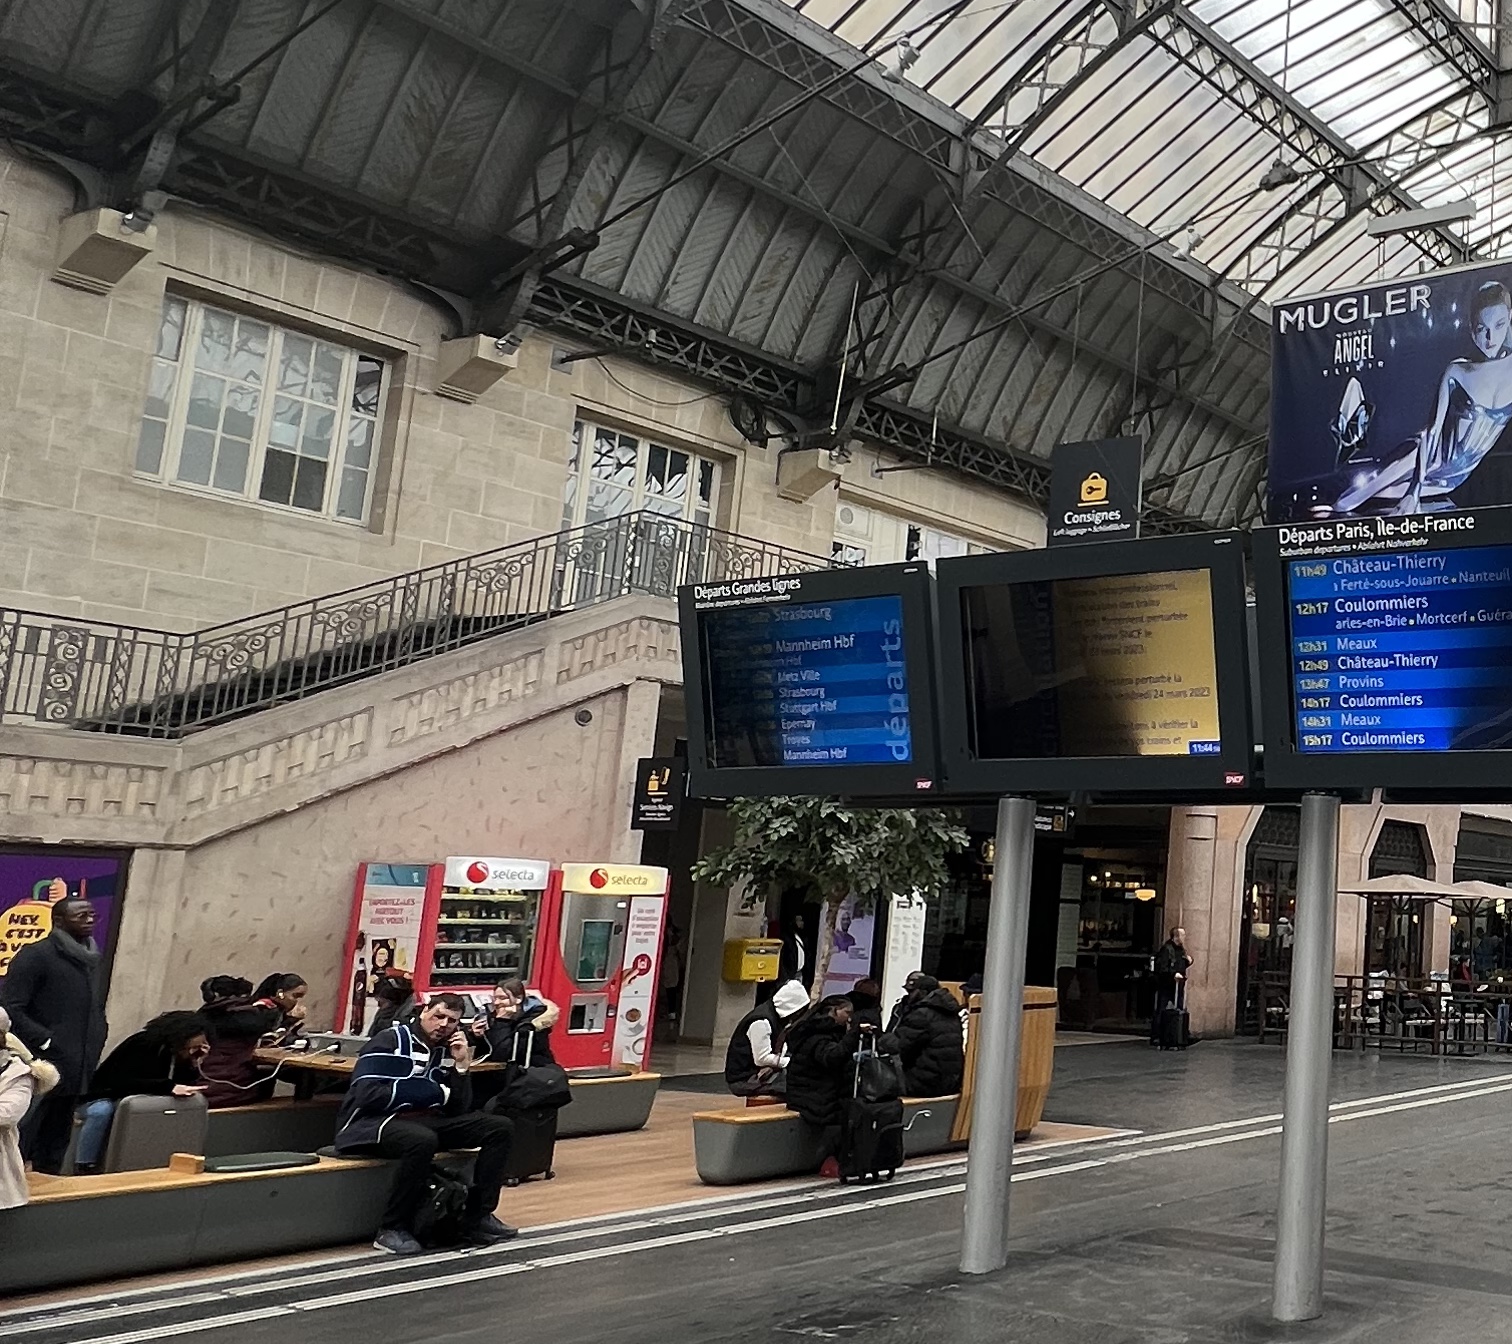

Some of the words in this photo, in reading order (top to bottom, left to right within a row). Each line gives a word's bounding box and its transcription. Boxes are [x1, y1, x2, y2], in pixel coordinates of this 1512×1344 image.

[1279, 284, 1431, 334] MUGLER
[1334, 333, 1375, 364] ANGEL
[1064, 510, 1121, 524] Consignes
[1279, 528, 1333, 546] Départs
[1336, 523, 1374, 539] Paris,
[1377, 515, 1475, 536] Île-de-France
[1333, 555, 1447, 575] Château-Thierry
[694, 585, 731, 601] Départs
[731, 580, 770, 596] Grandes
[774, 605, 833, 622] Strasbourg
[1296, 601, 1329, 616] 12h17
[1335, 595, 1429, 613] Coulommiers
[1416, 610, 1468, 626] Mortcerf
[775, 637, 832, 653] Mannheim
[1337, 638, 1378, 651] Meaux
[1337, 654, 1439, 670] Château-Thierry
[881, 617, 910, 760] départs
[1339, 675, 1384, 689] Provins
[1340, 693, 1423, 708] Coulommiers
[1341, 713, 1381, 726] Meaux
[1341, 731, 1426, 746] Coulommiers
[783, 748, 829, 760] Mannheim
[492, 869, 534, 881] selecta
[612, 874, 648, 886] selecta
